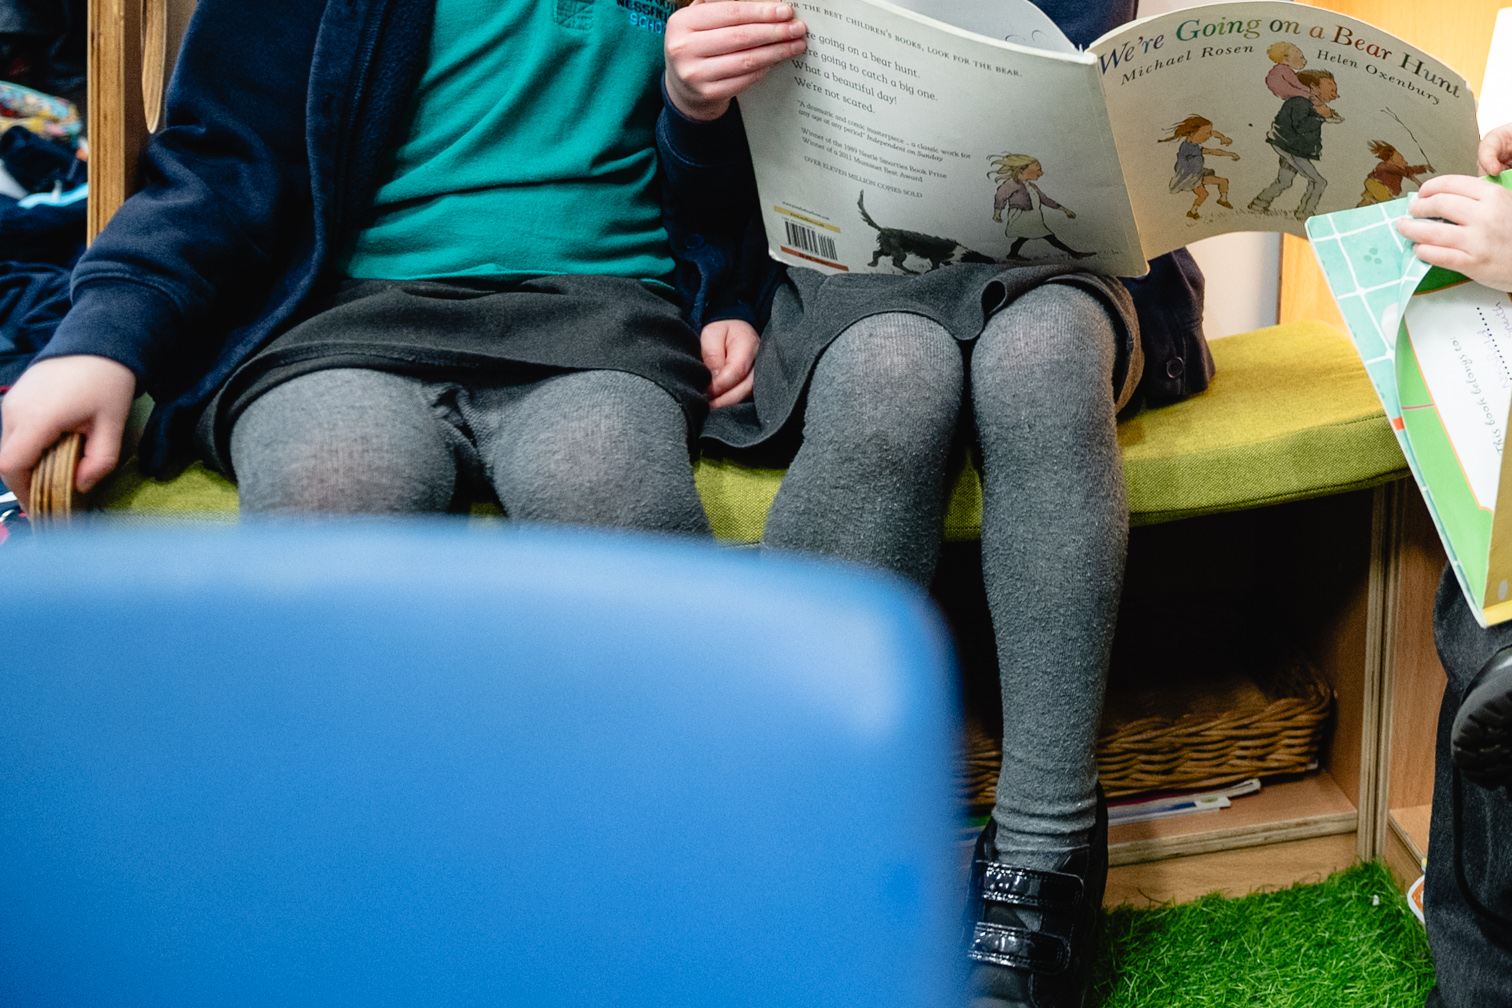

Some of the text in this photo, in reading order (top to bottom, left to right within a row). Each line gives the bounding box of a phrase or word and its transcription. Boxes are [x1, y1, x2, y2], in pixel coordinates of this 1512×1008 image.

[630, 12, 667, 35] SCHO
[802, 3, 821, 14] THE
[824, 8, 843, 21] BEST
[845, 16, 892, 40] CHILDREN'S
[894, 34, 925, 52] BOOKS,
[927, 46, 950, 60] LOOK
[952, 55, 971, 66] FOR
[972, 59, 993, 72] THE
[995, 66, 1023, 79] BEAR.
[819, 35, 846, 53] going
[848, 46, 860, 57] on
[862, 51, 869, 60] a
[870, 51, 893, 69] bear
[894, 60, 921, 79] hunt.
[821, 53, 848, 71] going
[849, 62, 860, 73] to
[862, 68, 889, 85] catch
[890, 79, 898, 88] a
[899, 80, 915, 96] big
[917, 89, 939, 102] one.
[1098, 16, 1461, 99] We're Going on a Bear Hunt
[1120, 44, 1255, 86] Michael Rosen
[1316, 49, 1441, 106] Helen Oxenbury
[792, 59, 898, 106] What a beautiful day!
[794, 76, 876, 114] We're not scared.
[1458, 354, 1482, 396] belongs
[1477, 397, 1496, 426] book
